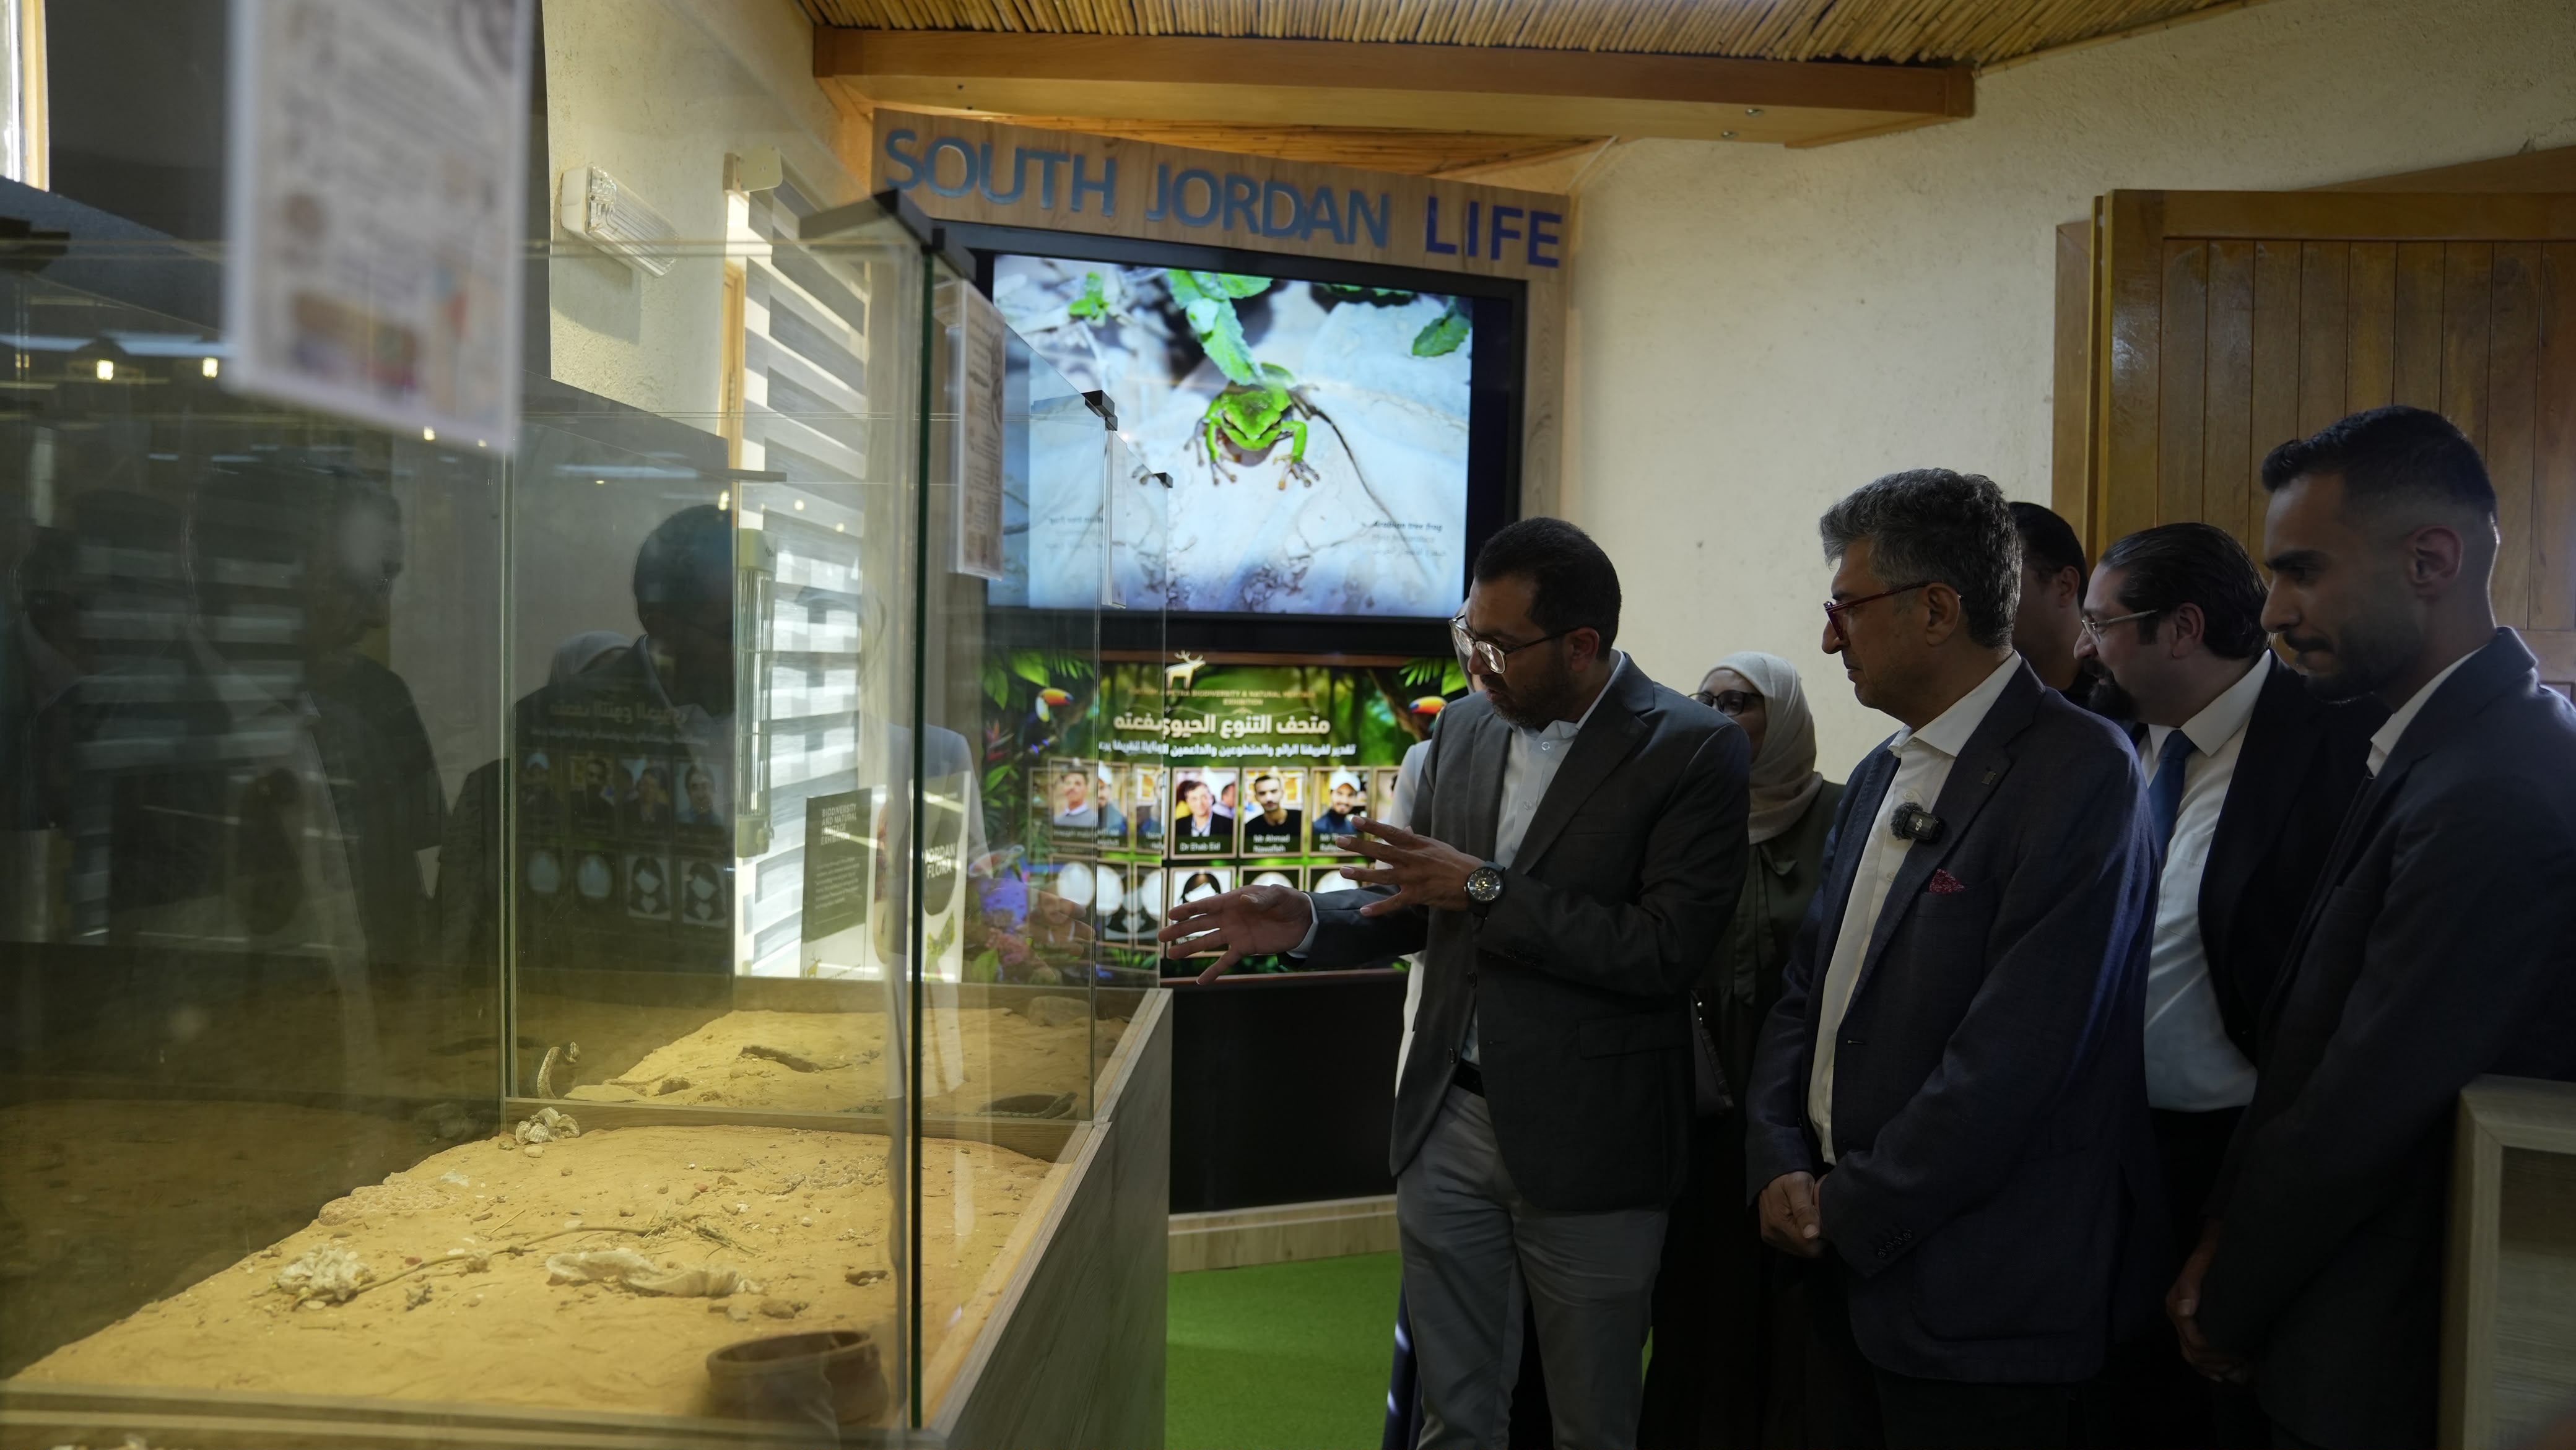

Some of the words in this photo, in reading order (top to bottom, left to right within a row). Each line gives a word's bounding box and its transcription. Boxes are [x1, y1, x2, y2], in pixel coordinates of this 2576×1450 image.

[884, 128, 1115, 217] SOUTH
[1145, 162, 1390, 247] JORDAN
[1425, 194, 1563, 269] LIFE
[1408, 522, 1424, 530] tree
[1425, 523, 1443, 533] frog
[1219, 714, 1273, 739] التنوع
[1276, 715, 1331, 734] متحف
[822, 803, 857, 817] BIODIVERSITY
[822, 817, 833, 826] AND
[834, 812, 858, 824] NATURAL
[925, 843, 956, 864] JORDAN
[926, 858, 952, 879] FLORA
